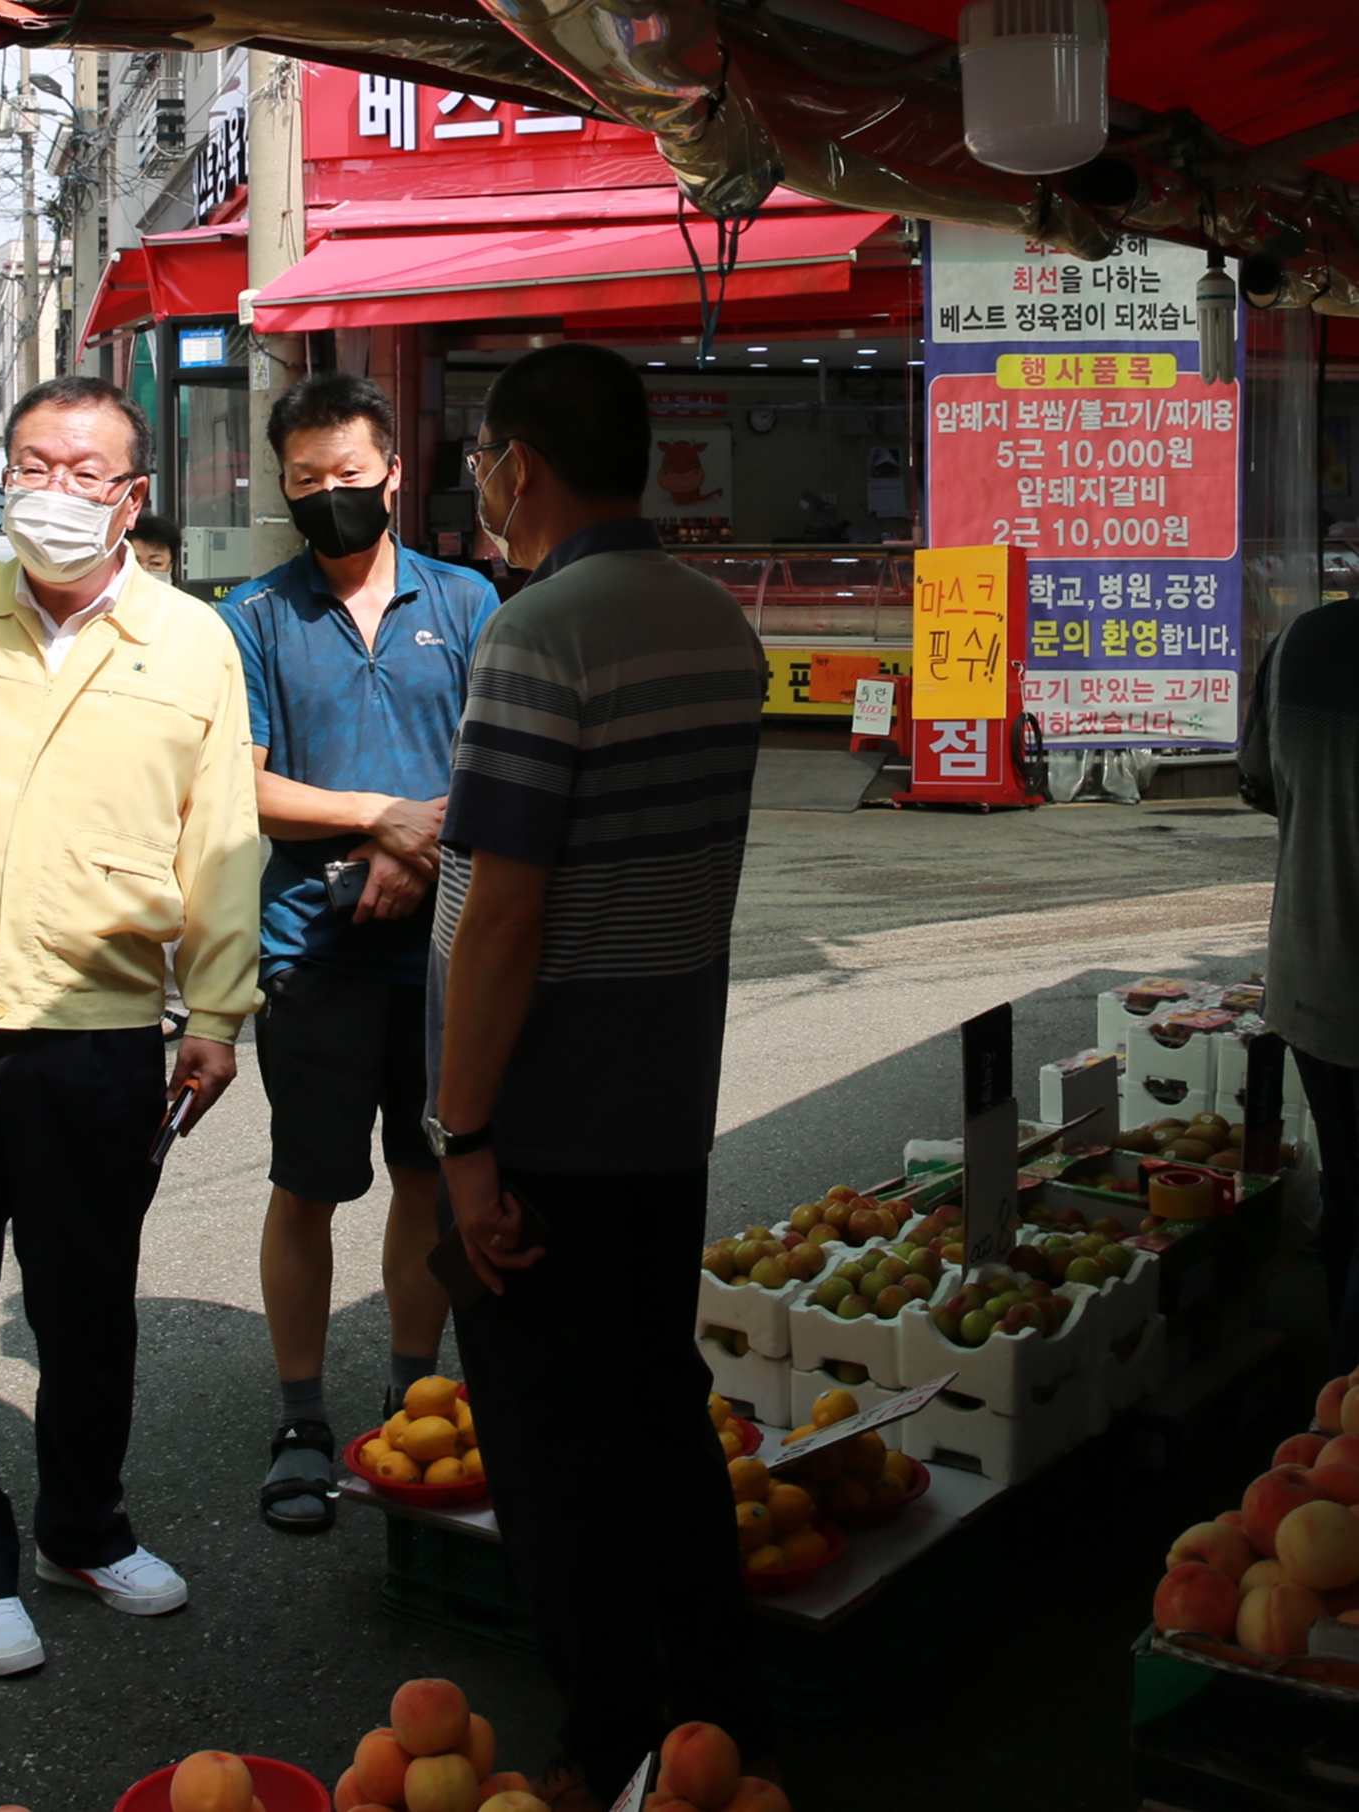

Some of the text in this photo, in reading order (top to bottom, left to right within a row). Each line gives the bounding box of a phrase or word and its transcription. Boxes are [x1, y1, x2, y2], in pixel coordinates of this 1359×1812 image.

[359, 73, 582, 151] 베스
[1013, 265, 1161, 294] 최선을 다하는
[940, 302, 1200, 333] 베스트 정육점이 되겠습니
[935, 399, 1234, 433] 암돼지 보쌈/불고기/찌개용
[997, 437, 1193, 471] 5근 10,000원
[1016, 476, 1165, 508] 암돼지갈비
[993, 516, 1189, 550] 2근 10,000원
[1029, 573, 1218, 611] 학교,병원,공장
[1031, 619, 1237, 657] 문의 환영합니다.
[1023, 677, 1232, 704] 고기 맛있는 고기만
[928, 720, 988, 777] 점
